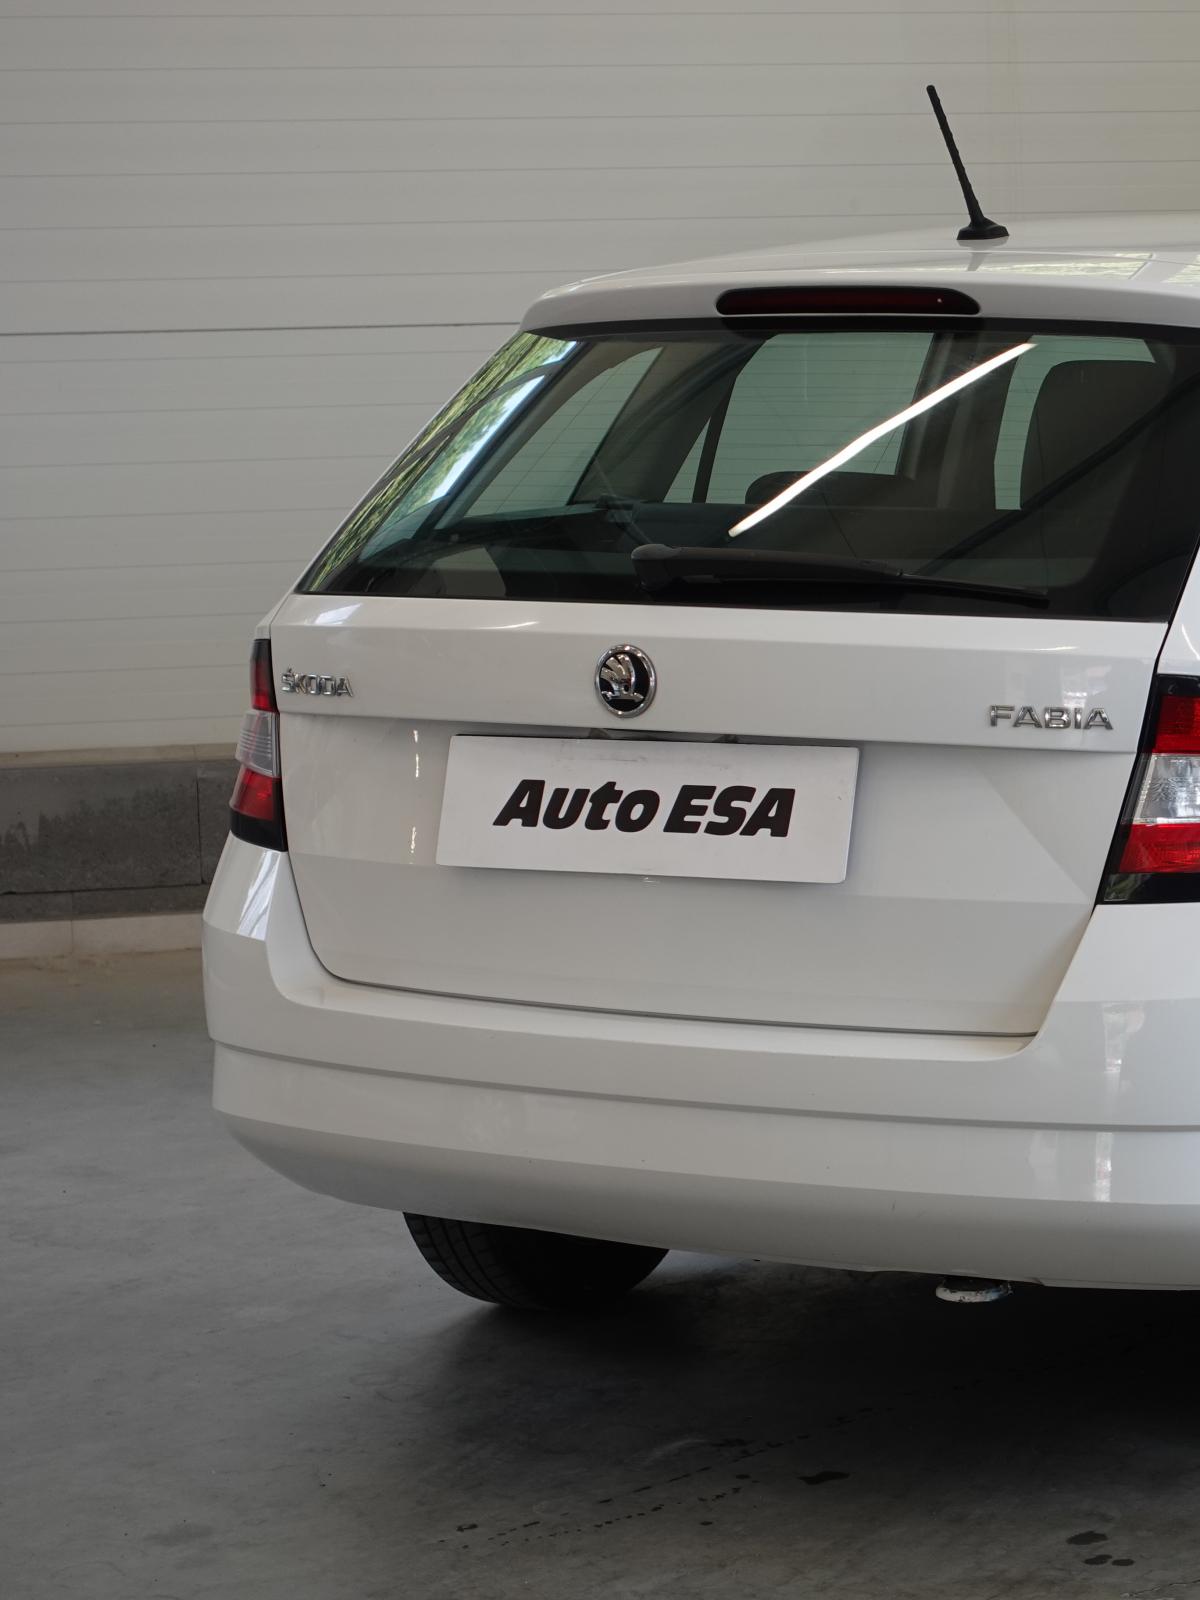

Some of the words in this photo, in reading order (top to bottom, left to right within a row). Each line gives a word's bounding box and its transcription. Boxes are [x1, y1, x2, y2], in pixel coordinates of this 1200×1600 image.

[989, 704, 1114, 731] FABIA
[492, 778, 661, 833] Auto
[662, 784, 796, 838] ESA
